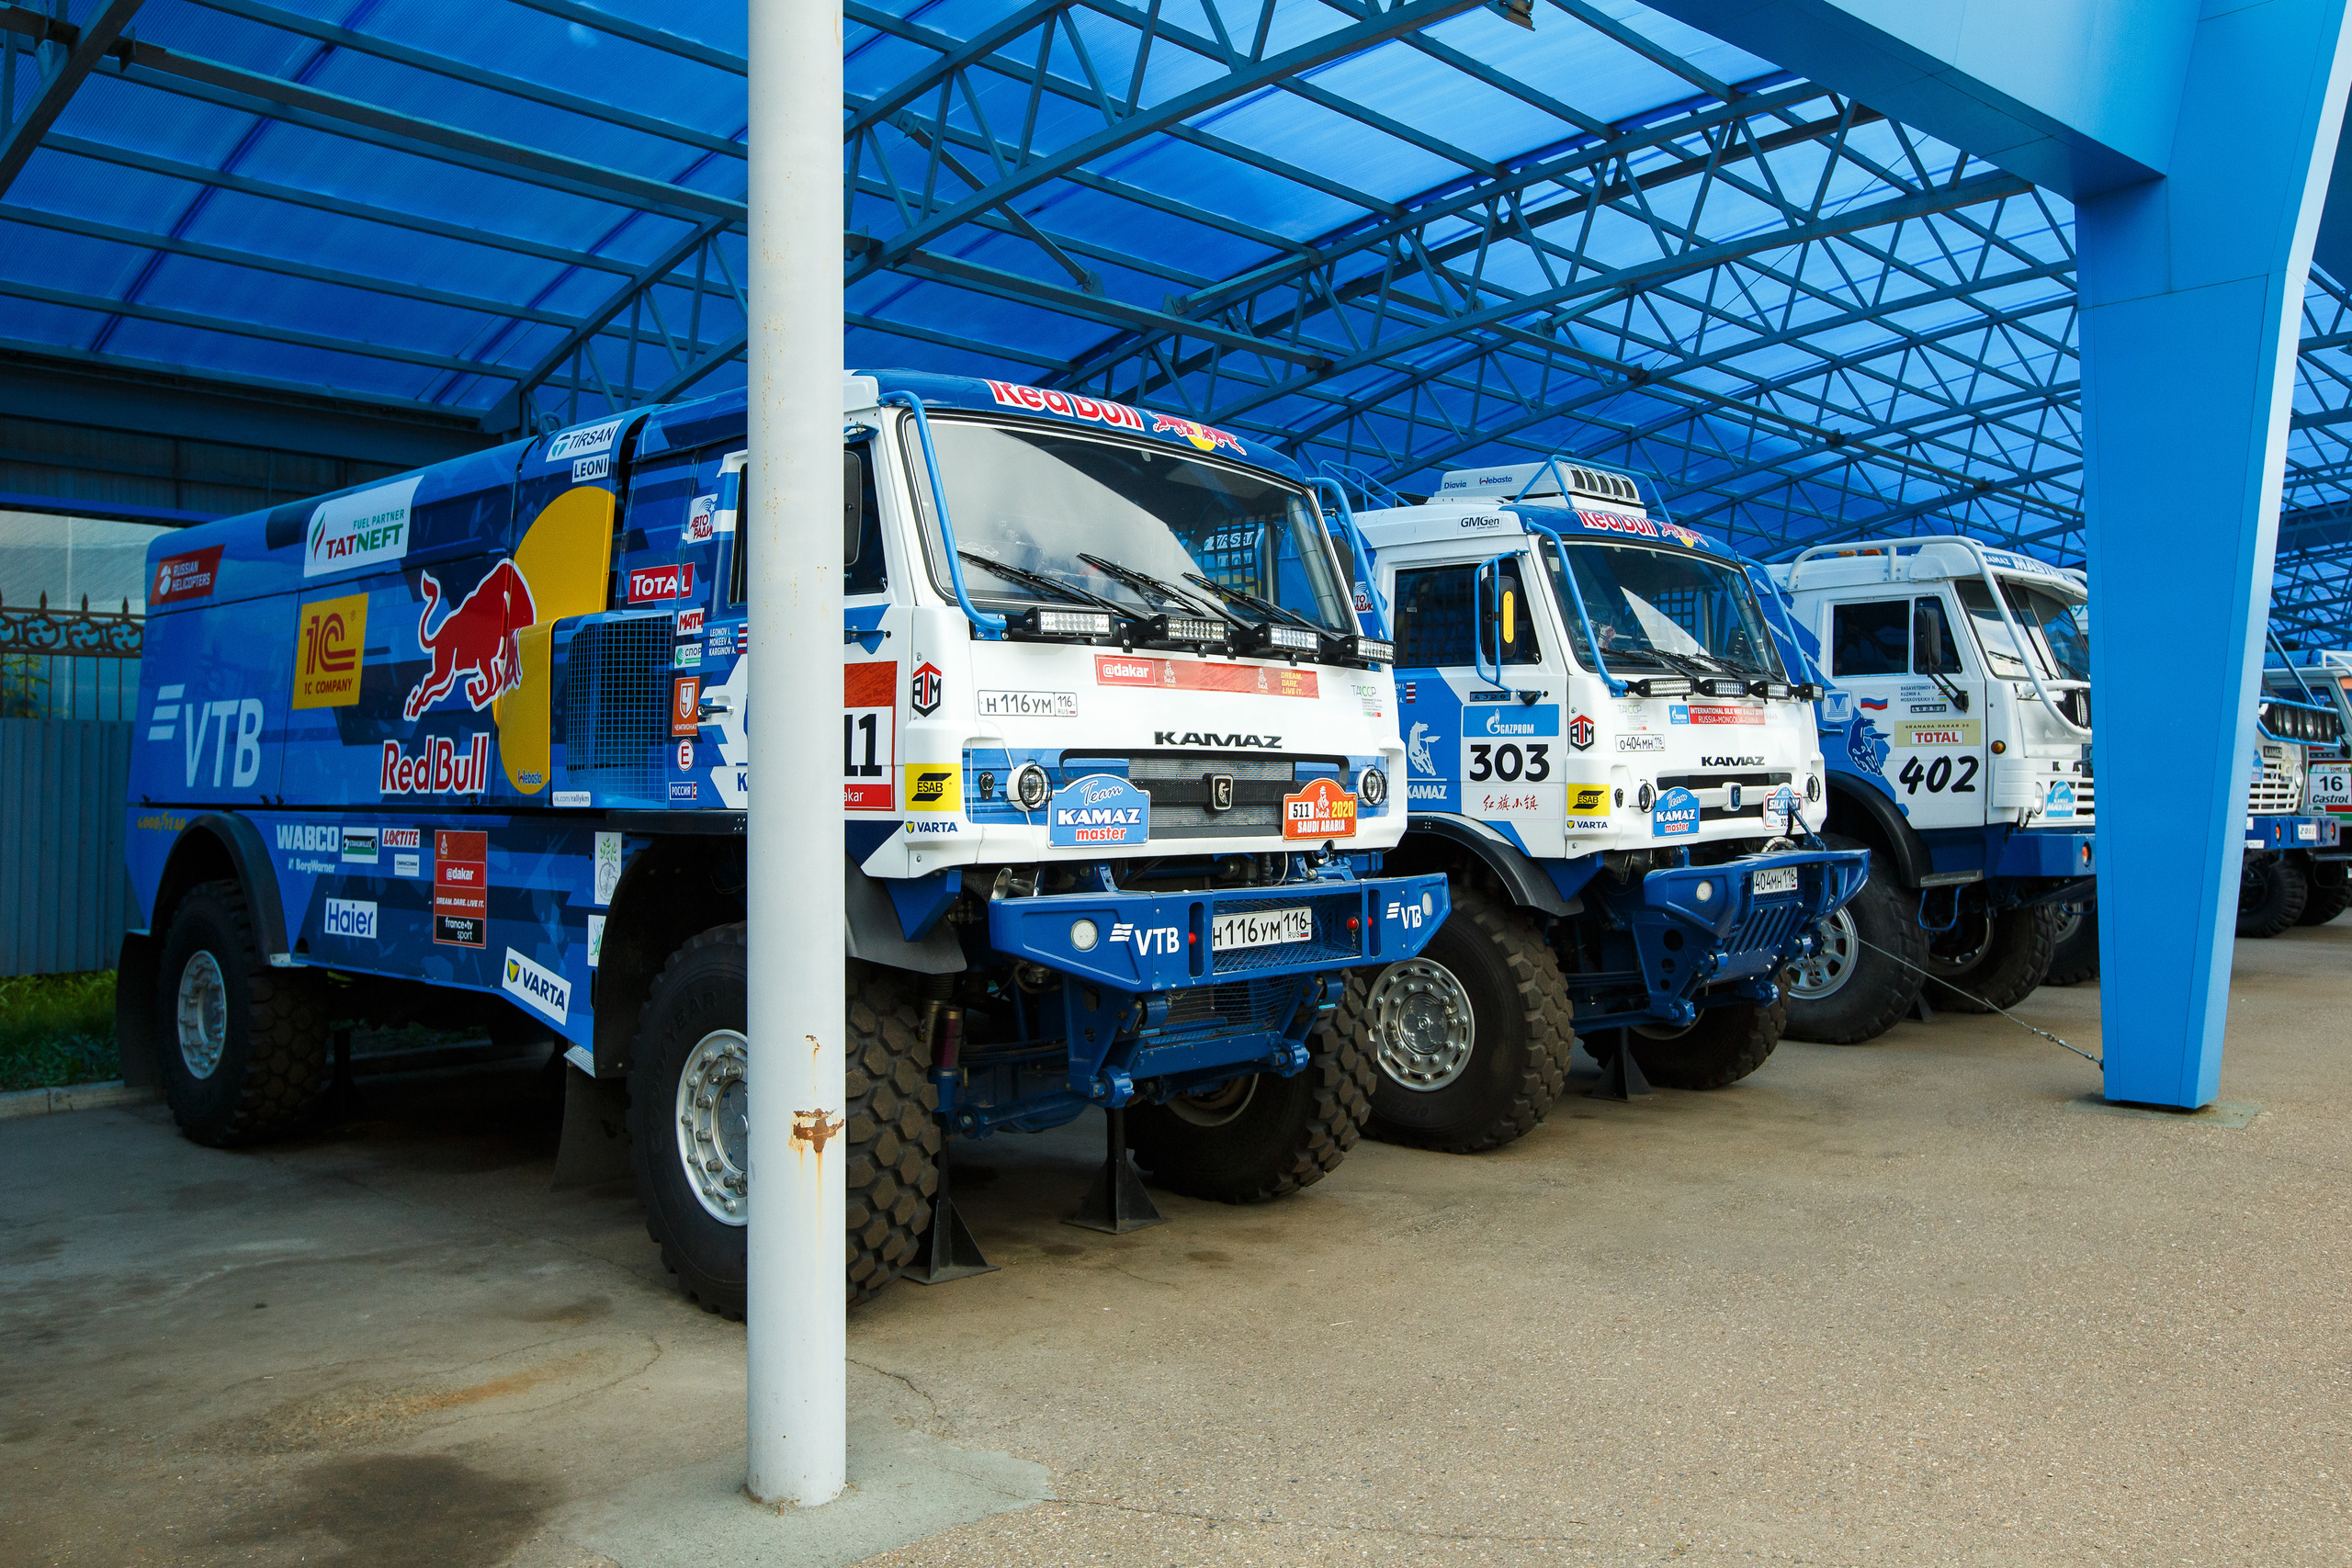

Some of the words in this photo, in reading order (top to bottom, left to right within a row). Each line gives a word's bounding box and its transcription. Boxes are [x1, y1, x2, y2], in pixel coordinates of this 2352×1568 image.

[982, 378, 1074, 418] Red
[1069, 393, 1146, 432] Bull
[573, 457, 607, 479] LEONI
[1444, 480, 1467, 490] Diavia
[1479, 476, 1512, 485] Webasto
[353, 517, 371, 531] FUEL
[371, 509, 405, 528] PARTNER
[690, 514, 708, 530] АВТО
[1573, 508, 1624, 532] Red
[1619, 513, 1659, 538] Bull
[693, 525, 713, 539] РАДИ
[325, 523, 404, 559] TATNEFT
[173, 560, 199, 576] RUSSIAN
[172, 573, 210, 592] HELICOPTERS
[633, 574, 689, 596] TOTAL
[685, 648, 702, 656] СПОР
[1102, 663, 1149, 678] @dakar
[1281, 671, 1302, 680] DREAM.
[315, 678, 354, 694] COMPANY
[1057, 695, 1073, 708] 116
[674, 723, 698, 731] ЧЕМПИОНАТ
[1500, 724, 1534, 734] GAZPROM
[185, 698, 264, 788] VTB
[844, 714, 882, 777] 11
[1154, 730, 1283, 749] KAMAZ
[1915, 731, 1959, 744] TOTAL
[681, 746, 689, 764] E
[1469, 743, 1550, 783] 303
[1702, 756, 1765, 766] KAMAZ
[380, 736, 434, 795] Red
[433, 732, 490, 795] Bull
[517, 768, 542, 786] Webasto
[1898, 755, 1980, 795] 402
[2319, 775, 2344, 791] 16
[672, 785, 691, 796] РОССИЯ
[917, 782, 944, 793] ESAB
[1080, 780, 1124, 806] Team
[553, 795, 589, 804] vk.com/rallykm
[843, 789, 864, 803] akar
[1483, 794, 1539, 811] 红旗小镇
[1577, 795, 1599, 804] ESAB
[1769, 799, 1785, 809] SILK
[2312, 795, 2348, 804] Castrol
[1057, 807, 1142, 826] KAMAZ
[1293, 804, 1309, 818] 511
[1331, 800, 1354, 818] 2020
[1656, 808, 1696, 822] KAMAZ
[918, 821, 957, 833] VARTA
[1297, 820, 1319, 833] SAUDI
[1320, 819, 1345, 832] ARABIA
[1577, 821, 1608, 829] VARTA
[1665, 822, 1689, 832] master
[276, 825, 339, 852] WABCO
[383, 829, 419, 846] LOCTITE
[1076, 827, 1127, 841] master
[296, 859, 335, 874] BorgWarner
[447, 867, 474, 881] @dakar
[436, 897, 453, 906] DREAM.
[453, 897, 467, 907] DARE.
[467, 899, 478, 908] LIVE
[327, 902, 374, 935] Haier
[1283, 911, 1307, 931] 116
[1400, 905, 1422, 929] VTB
[457, 931, 472, 942] sport
[1134, 926, 1180, 956] VTB
[523, 966, 566, 1011] VARTA
